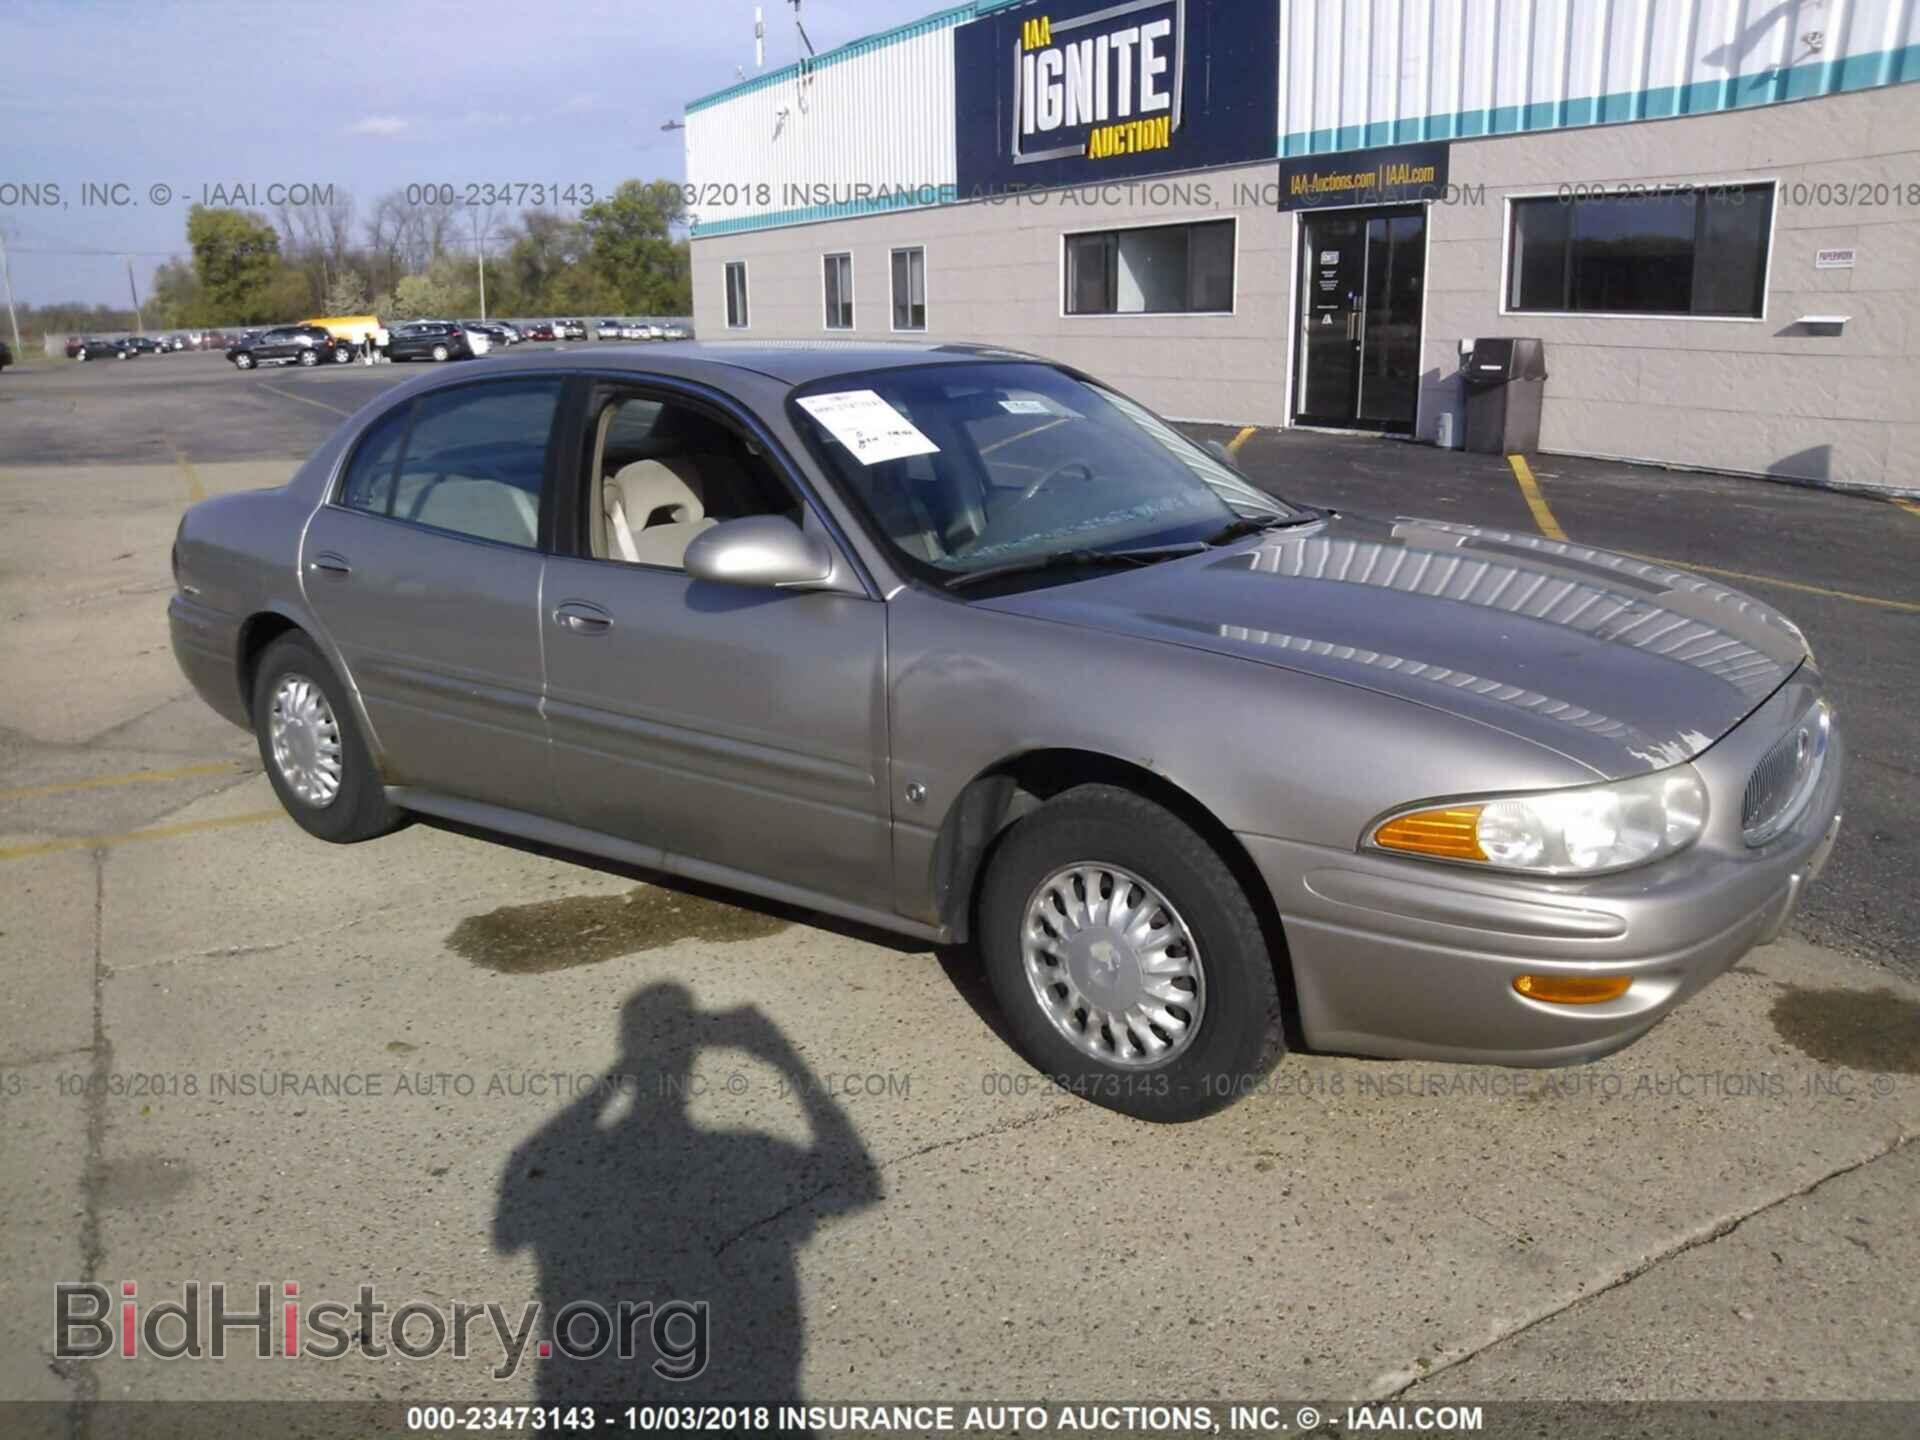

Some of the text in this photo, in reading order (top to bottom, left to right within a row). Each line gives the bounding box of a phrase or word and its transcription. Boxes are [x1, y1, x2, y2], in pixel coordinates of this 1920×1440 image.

[1023, 15, 1052, 51] IAA
[1023, 18, 1171, 135] IGNITE
[1087, 115, 1170, 160] AUCTION
[1290, 171, 1376, 195] IAA-Auctions.com
[1386, 163, 1435, 185] IAAI.com
